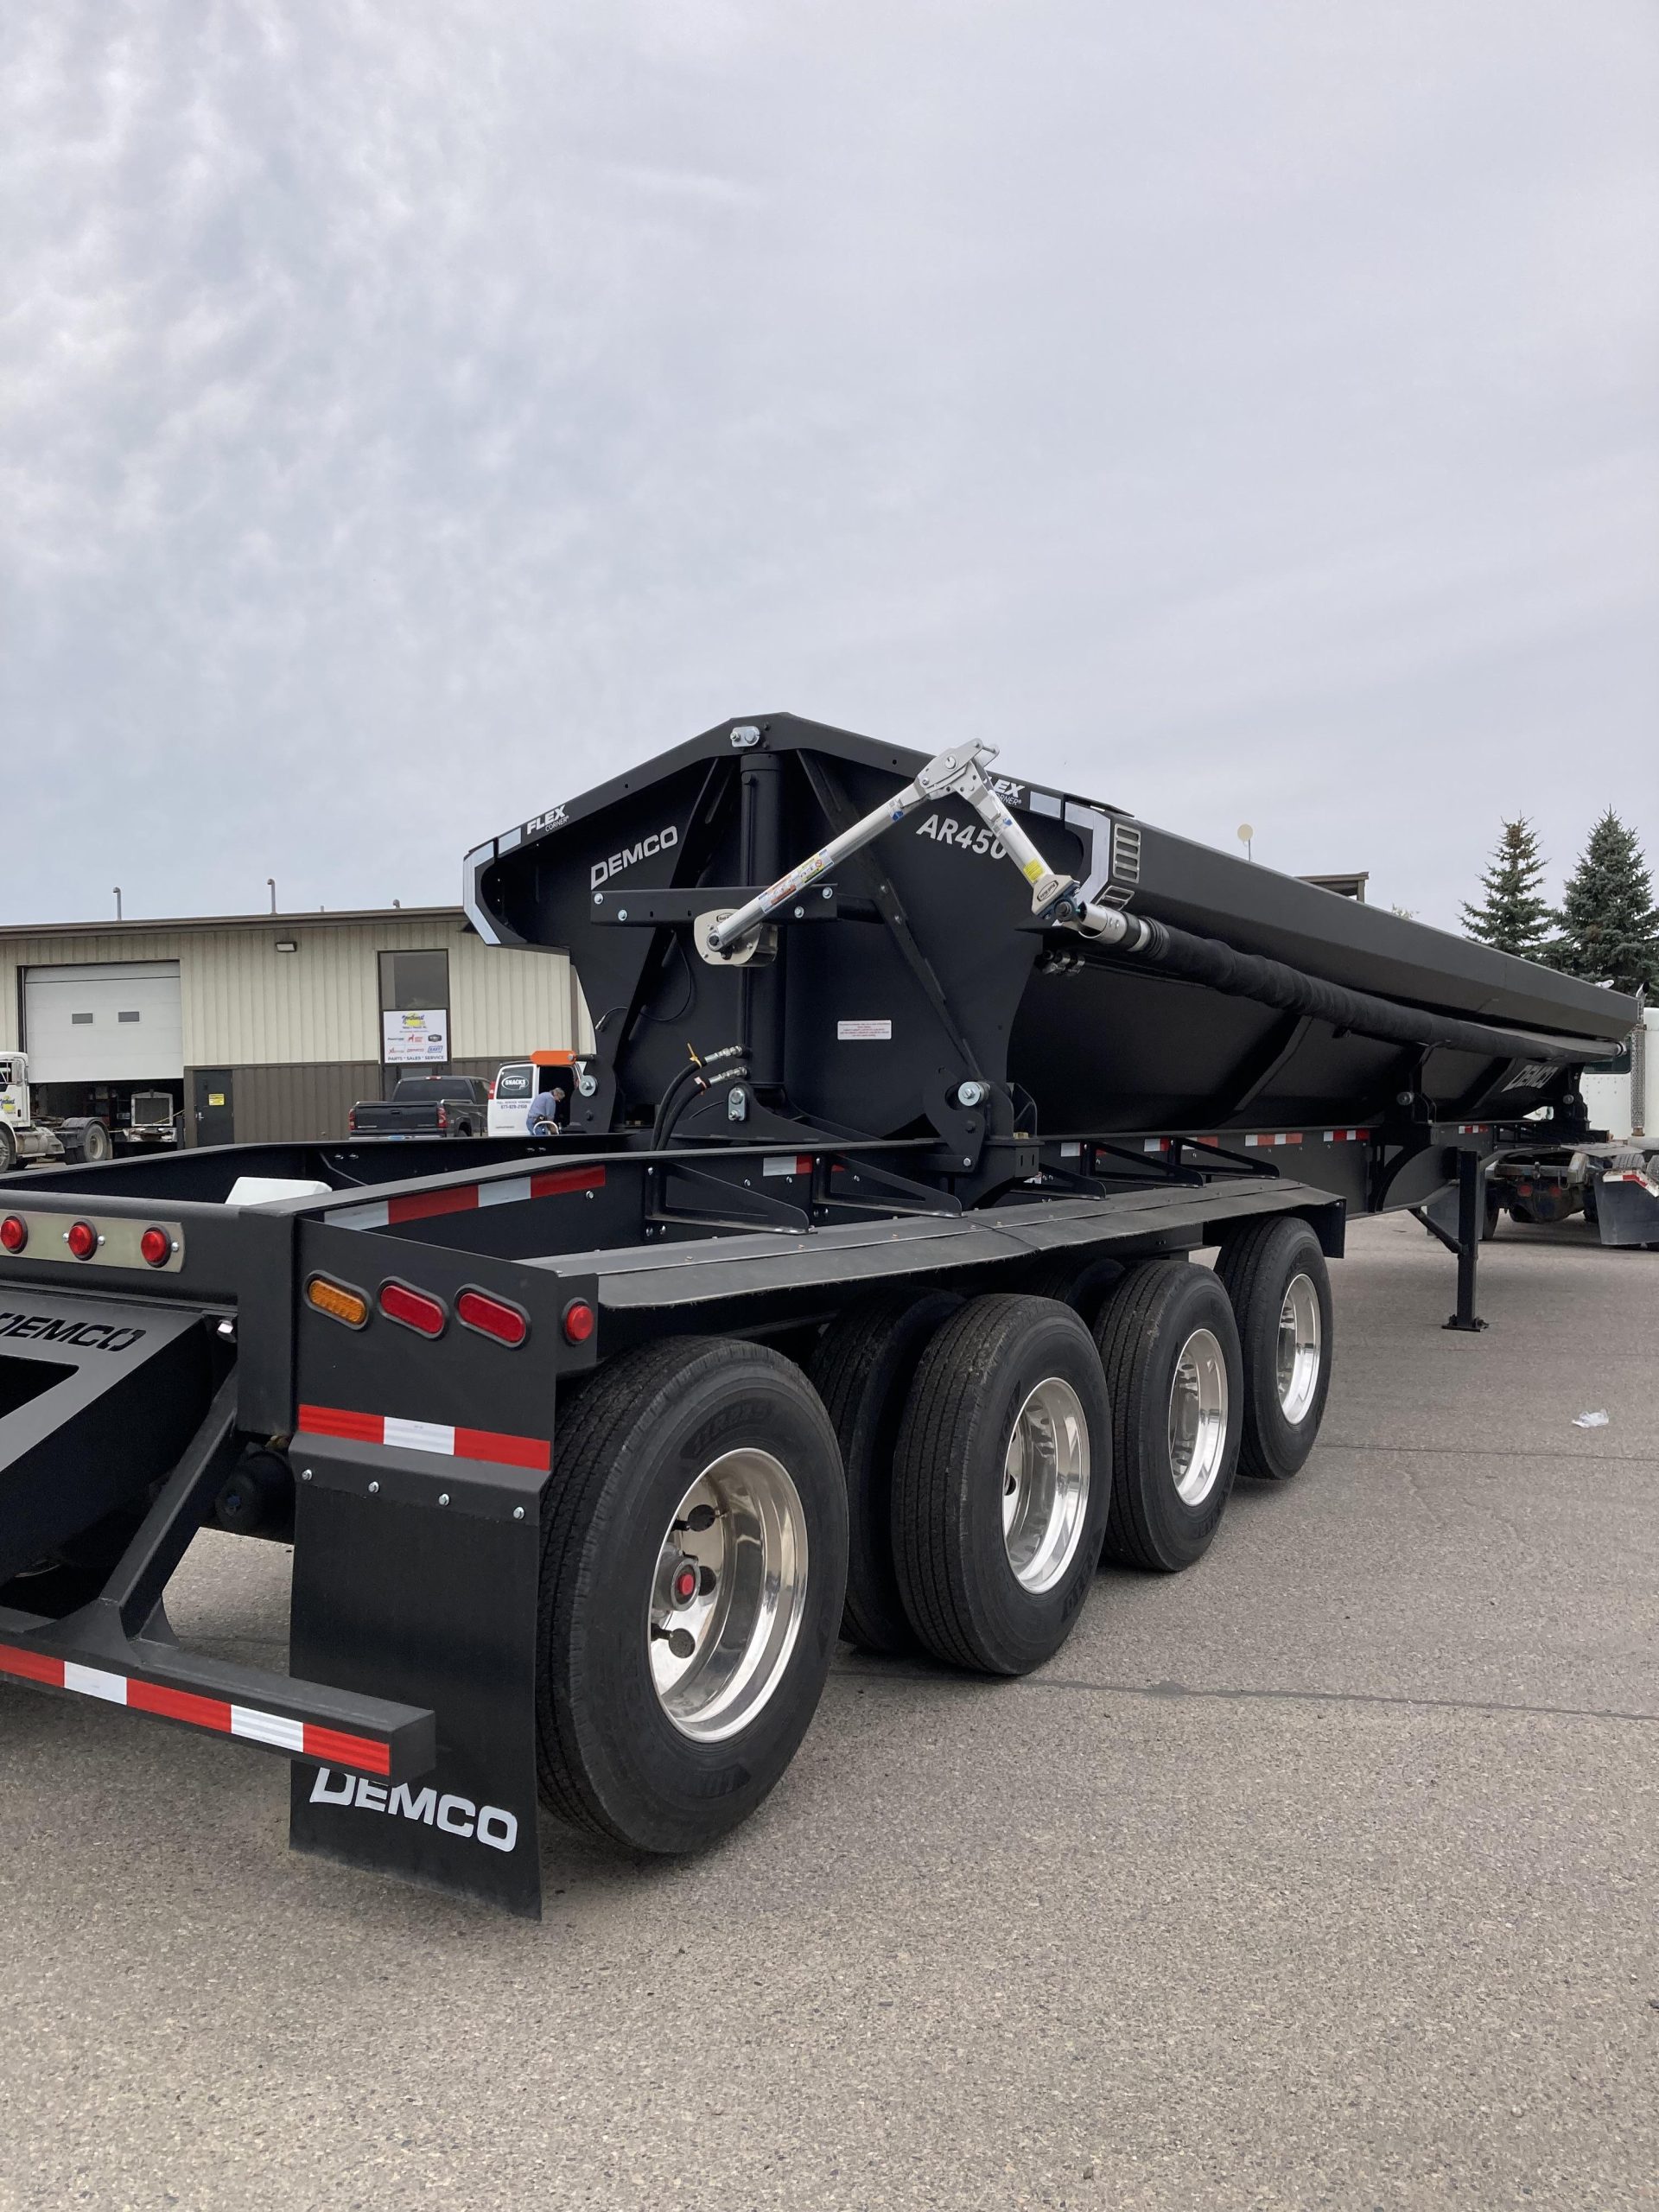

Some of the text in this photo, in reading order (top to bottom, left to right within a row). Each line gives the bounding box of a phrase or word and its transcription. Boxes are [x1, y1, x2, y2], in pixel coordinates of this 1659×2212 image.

[988, 777, 1026, 798] EX
[526, 804, 566, 835] FLEX
[916, 814, 1007, 860] AR450
[590, 825, 678, 891] DEMCO
[309, 1767, 518, 1853] DEMCO
